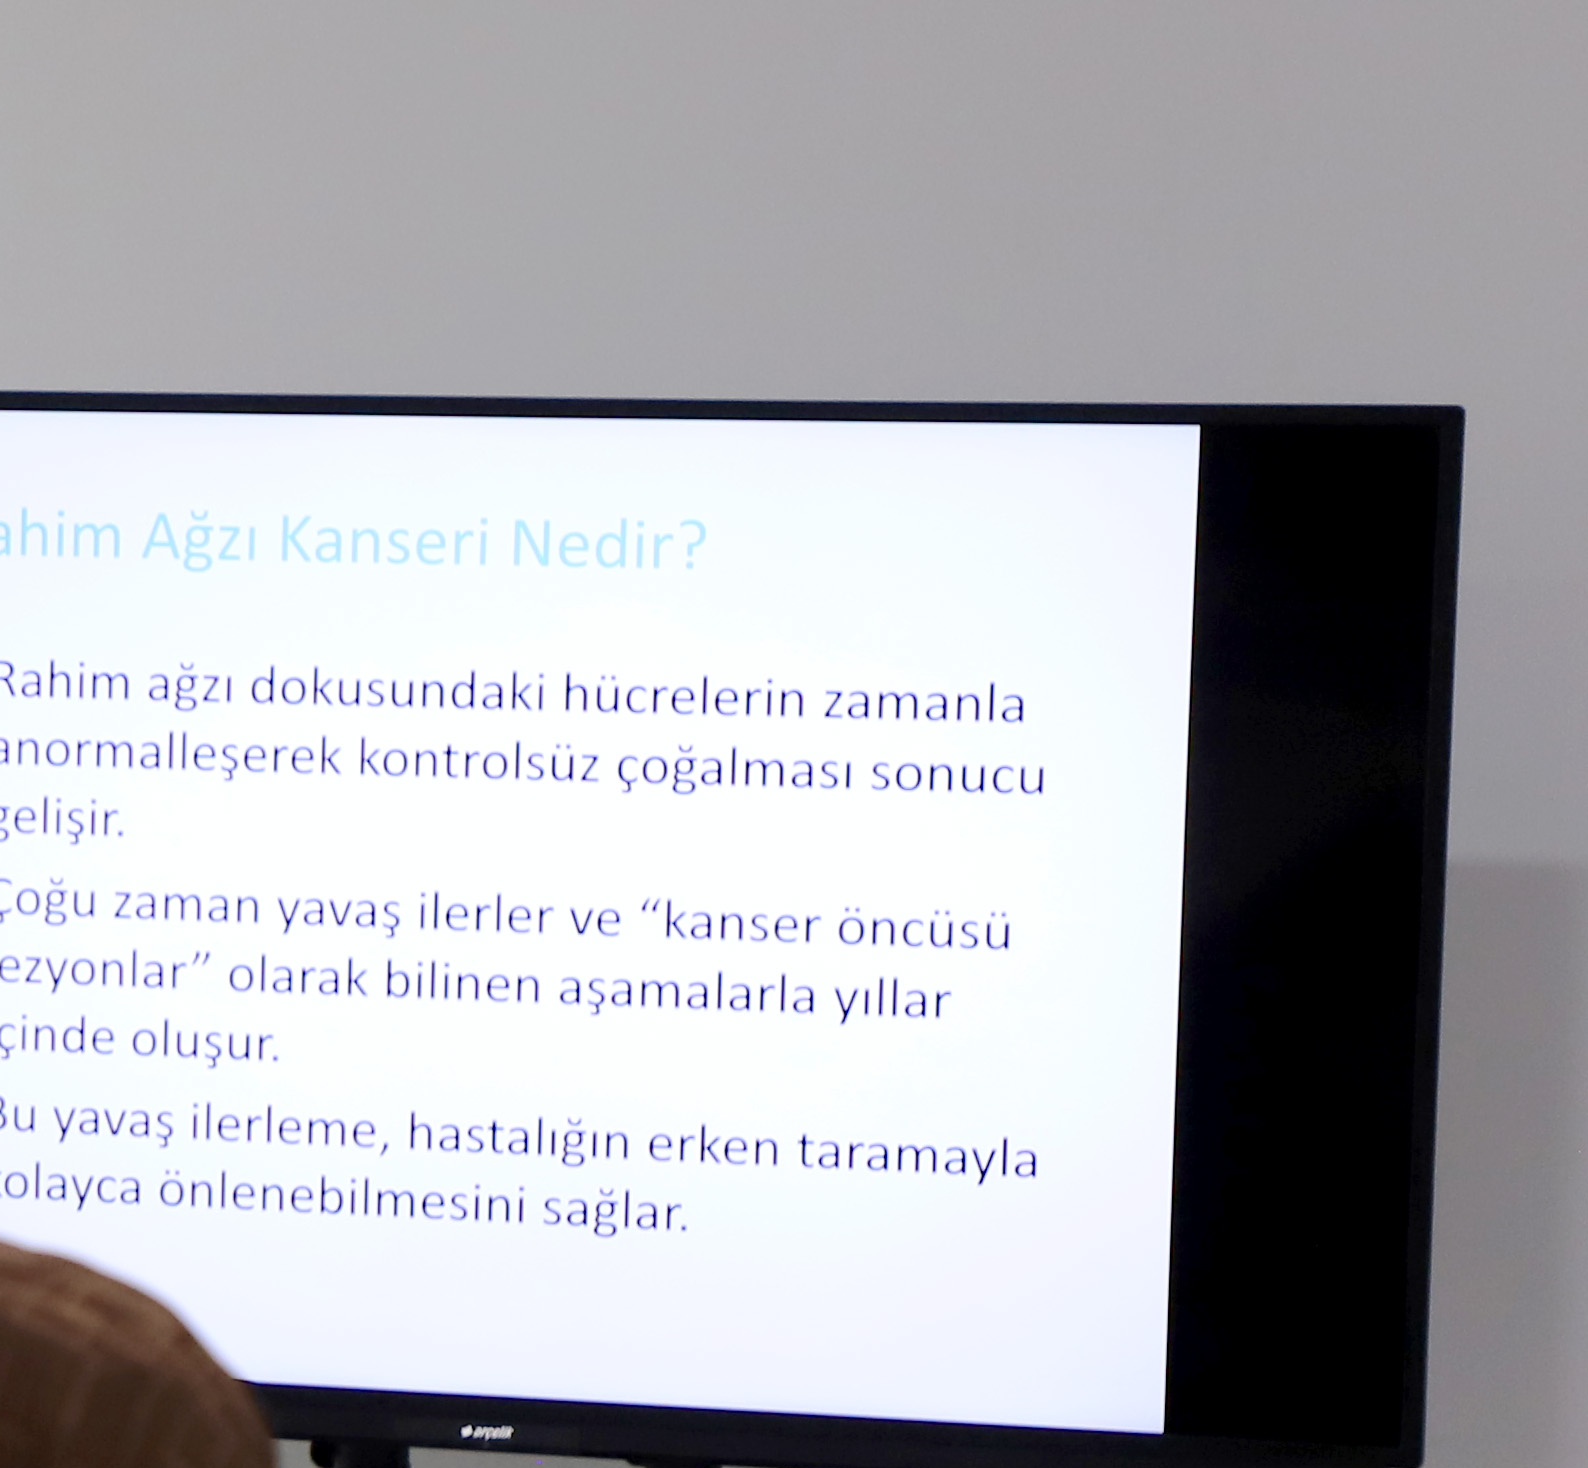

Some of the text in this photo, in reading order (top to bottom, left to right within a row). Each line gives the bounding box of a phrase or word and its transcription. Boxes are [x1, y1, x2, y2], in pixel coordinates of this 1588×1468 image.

[141, 510, 257, 574] Ağzı
[281, 514, 489, 567] Kanseri
[512, 517, 708, 570] Nedir?
[147, 661, 234, 714] ağzı
[249, 663, 546, 713] dokusundaki
[563, 670, 806, 719] hücrelerin
[822, 680, 1026, 725] zamanla
[358, 734, 601, 784] kontrolsüz
[616, 743, 853, 797] çoğalması
[870, 760, 1046, 796] sonucu
[112, 890, 261, 925] zaman
[276, 896, 402, 940] yavaş
[418, 889, 556, 936] ilerler
[568, 906, 623, 939] ve
[836, 905, 1012, 952] öncüsü
[227, 952, 369, 998] olarak
[385, 957, 541, 1005] bilinen
[558, 969, 816, 1018] aşamalarla
[833, 975, 953, 1027] yıllar
[130, 1017, 280, 1071] oluşur.
[52, 1105, 175, 1150] yavaş
[191, 1100, 390, 1158] ilerleme,
[408, 1109, 630, 1169] hastalığın
[647, 1122, 780, 1168] erken
[796, 1132, 1039, 1188] taramayla
[158, 1168, 526, 1225] önlenebilmesini
[542, 1186, 689, 1240] sağlar.
